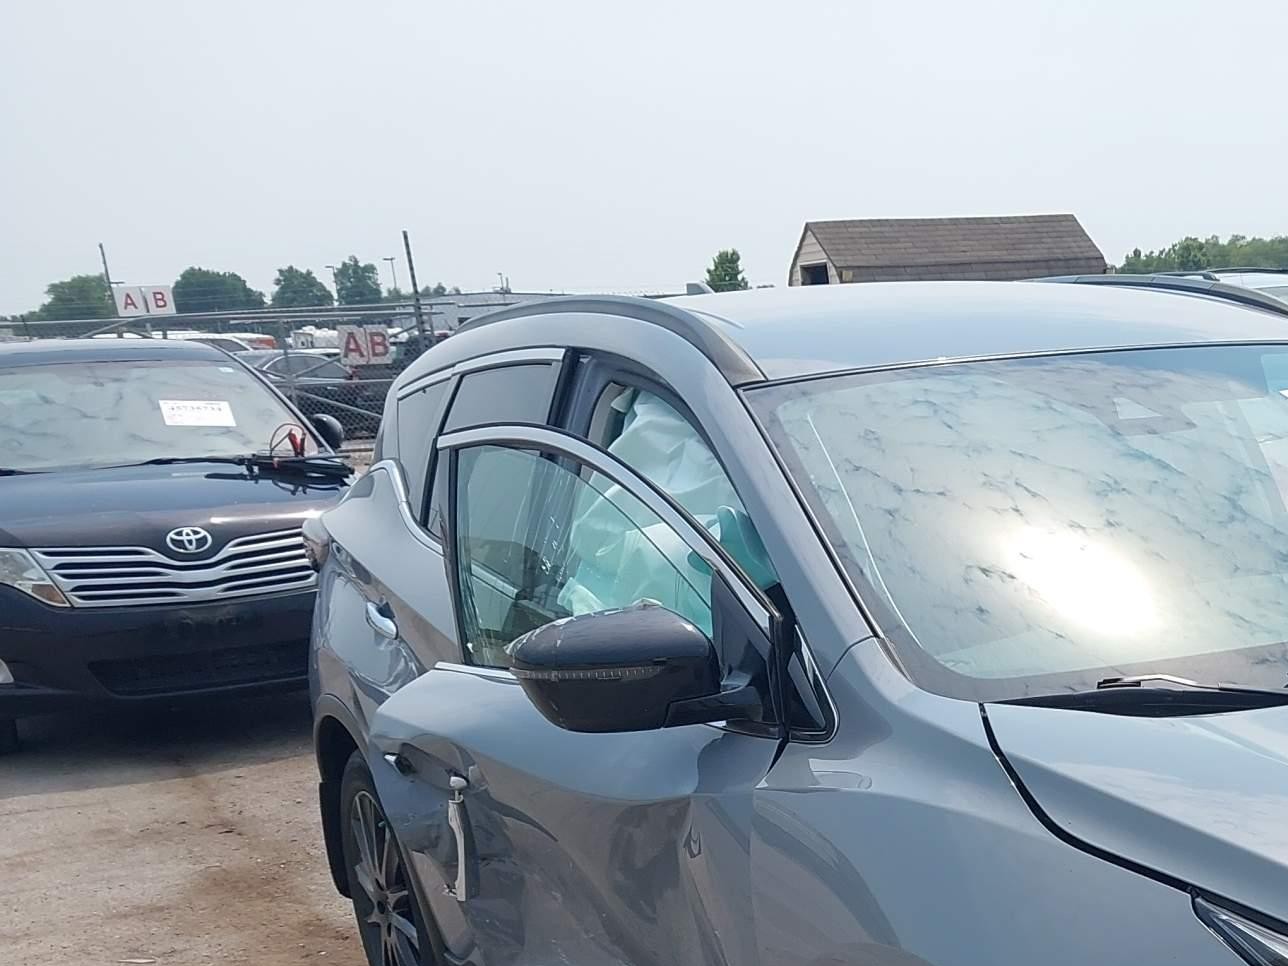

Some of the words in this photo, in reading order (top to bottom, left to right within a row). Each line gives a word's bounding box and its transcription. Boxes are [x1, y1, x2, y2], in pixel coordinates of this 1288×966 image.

[123, 293, 138, 310] A
[152, 291, 167, 308] B
[343, 332, 366, 358] A
[370, 332, 389, 357] B
